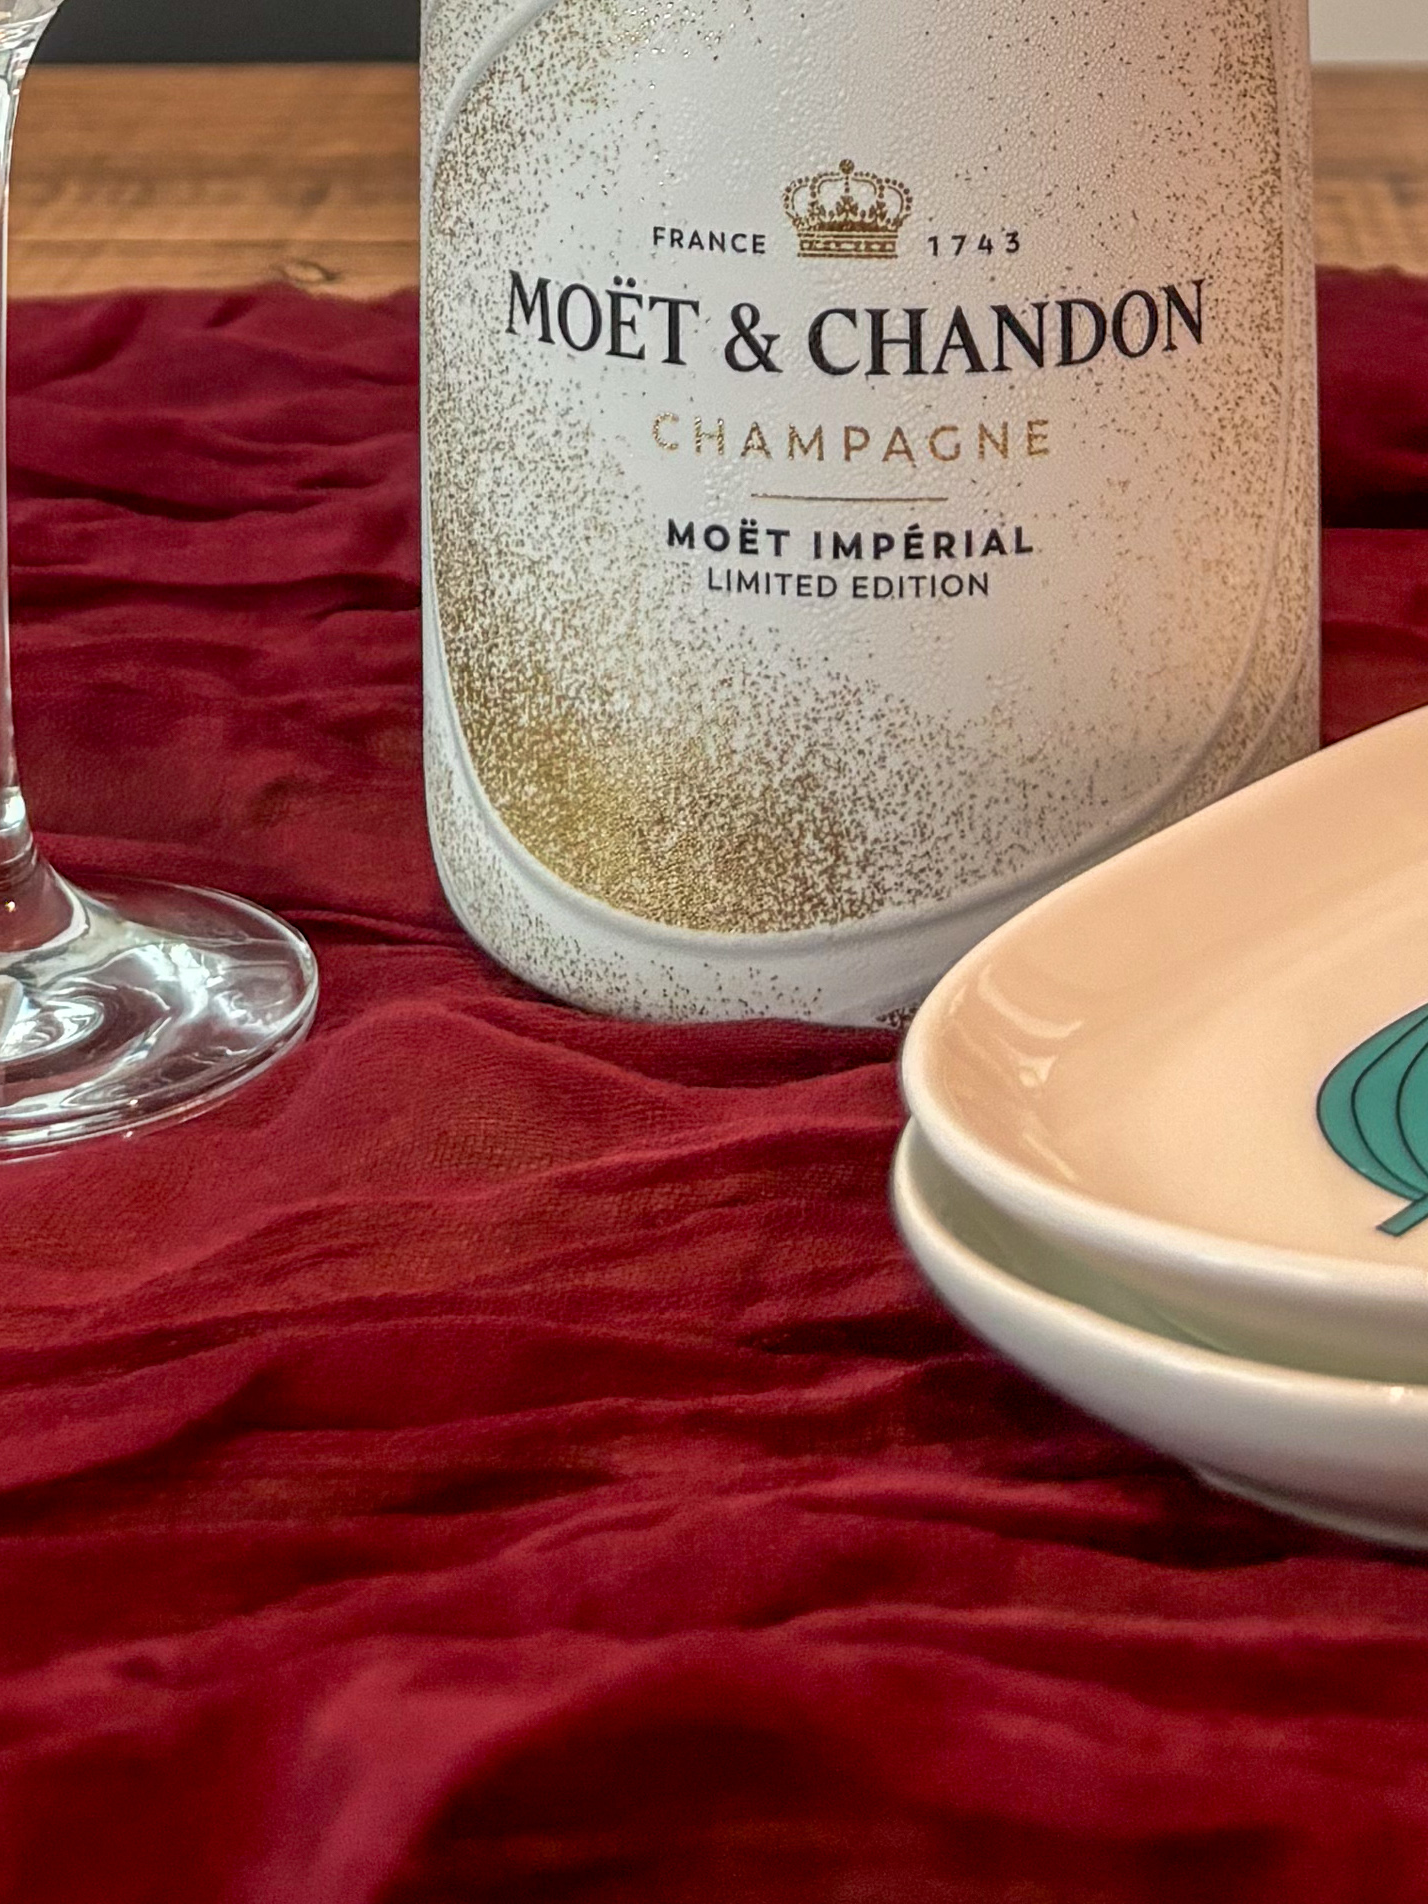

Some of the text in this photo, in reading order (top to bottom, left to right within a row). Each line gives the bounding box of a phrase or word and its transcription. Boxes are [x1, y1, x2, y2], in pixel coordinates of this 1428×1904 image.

[652, 226, 767, 256] FRANCE
[504, 270, 1206, 377] MOËT & CHANDON
[652, 411, 1050, 463] CHAMPAGNE
[666, 518, 1034, 561] MOËT IMPÉRIAL
[706, 566, 990, 600] LIMITED EDITION
